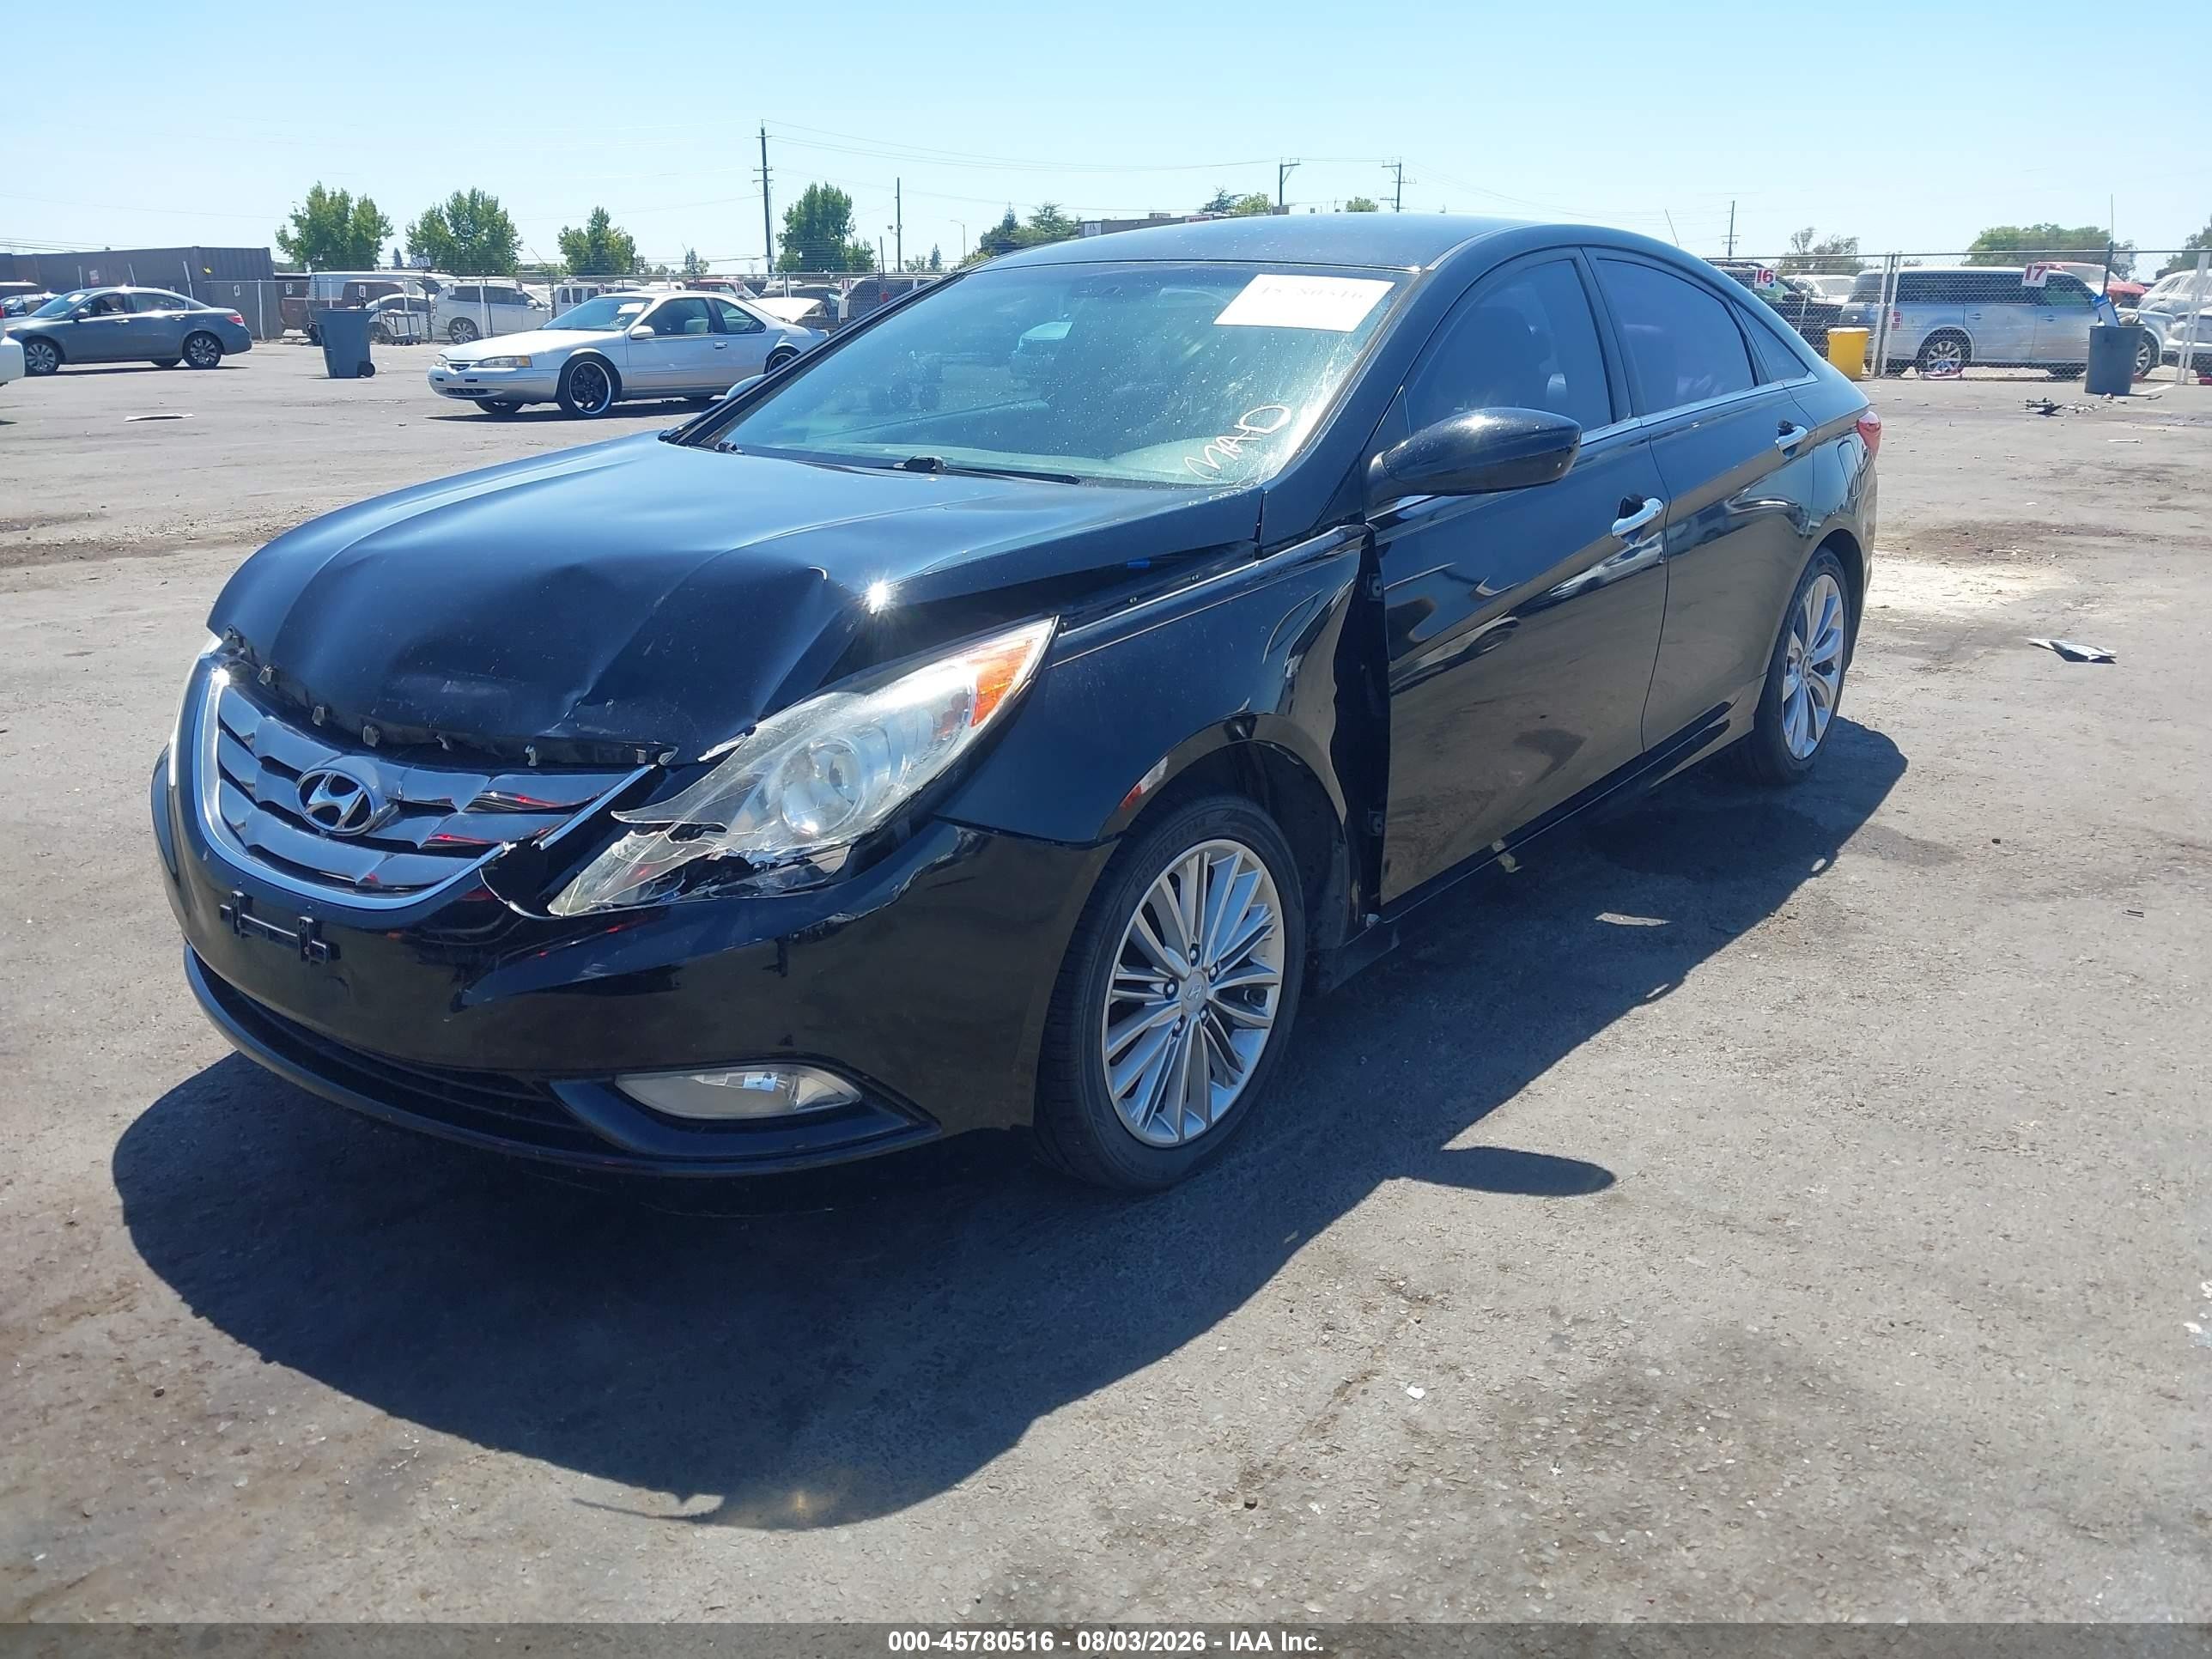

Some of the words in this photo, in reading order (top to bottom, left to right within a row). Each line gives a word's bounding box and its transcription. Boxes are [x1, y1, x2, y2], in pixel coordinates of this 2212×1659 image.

[1757, 269, 1774, 283] 16
[2025, 264, 2047, 281] 17
[599, 283, 605, 293] 9
[736, 282, 744, 292] 10
